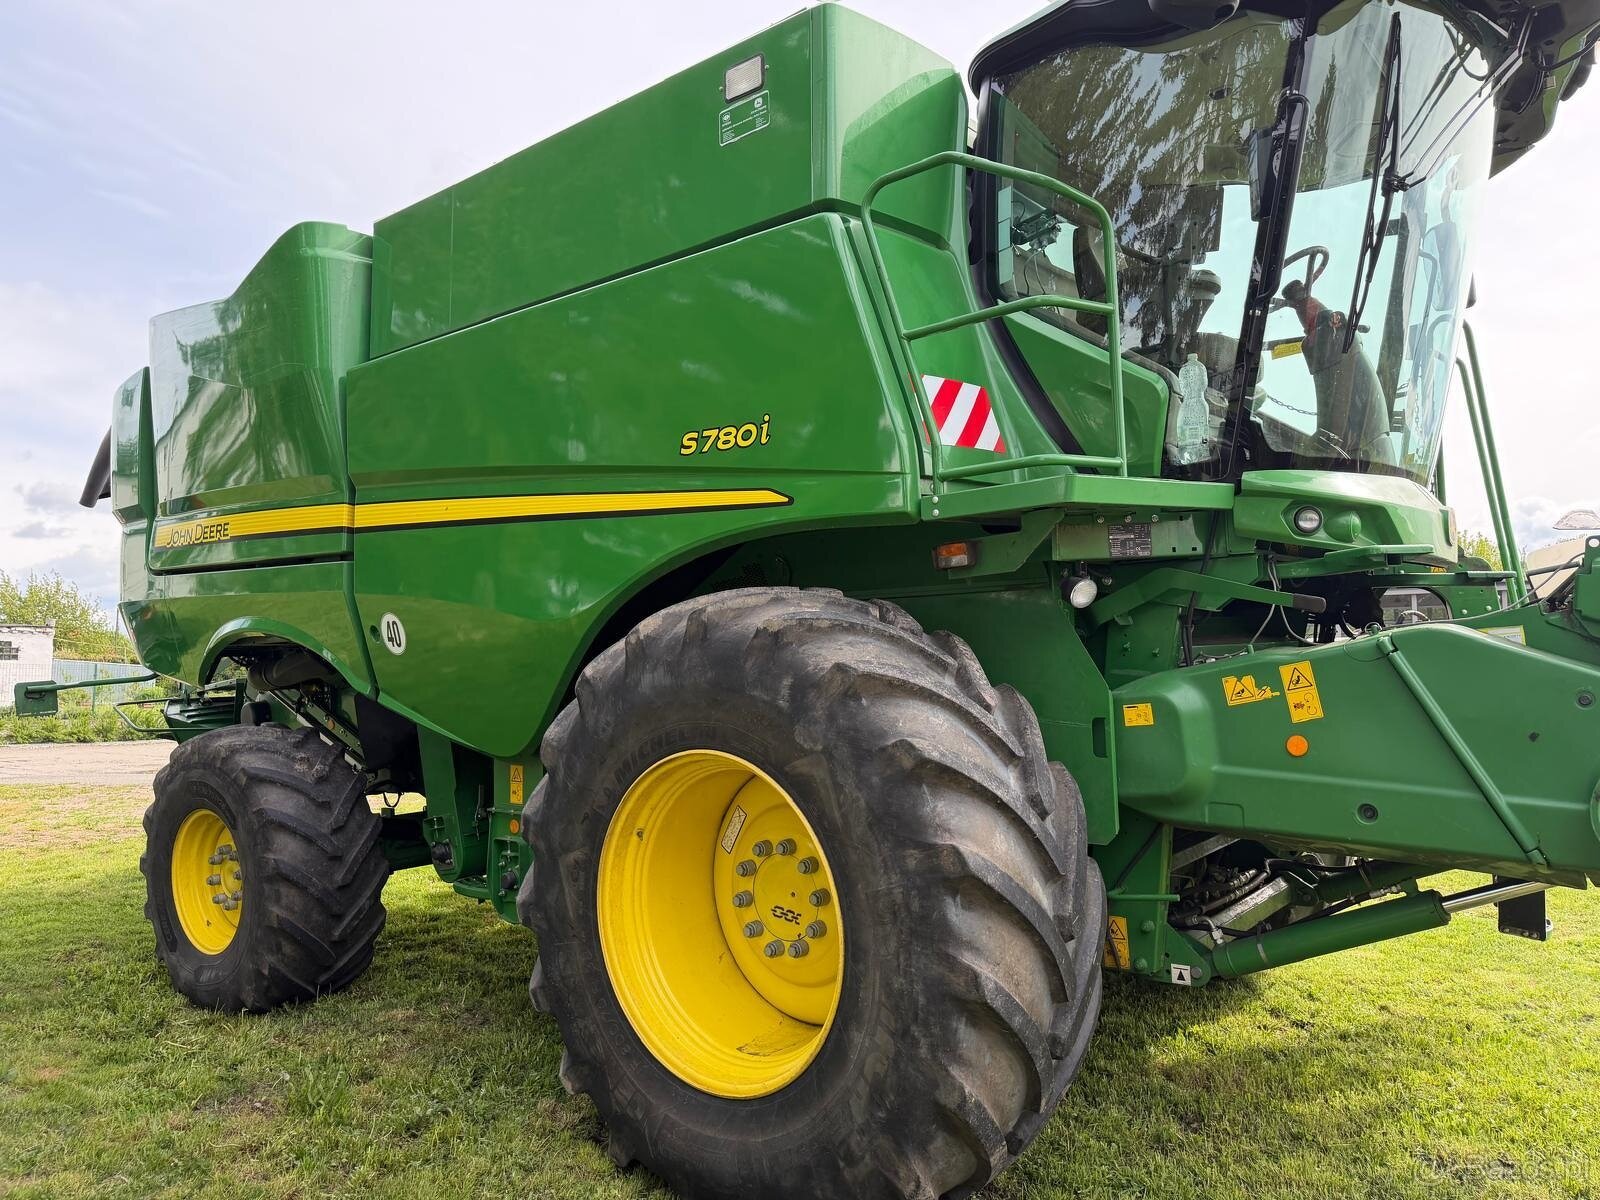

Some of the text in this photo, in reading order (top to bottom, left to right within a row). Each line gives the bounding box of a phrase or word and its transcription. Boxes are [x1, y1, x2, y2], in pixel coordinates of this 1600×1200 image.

[680, 413, 770, 456] S780i
[166, 522, 230, 546] JOHN DEERE
[386, 620, 402, 648] 40
[614, 726, 719, 785] MICHELIN
